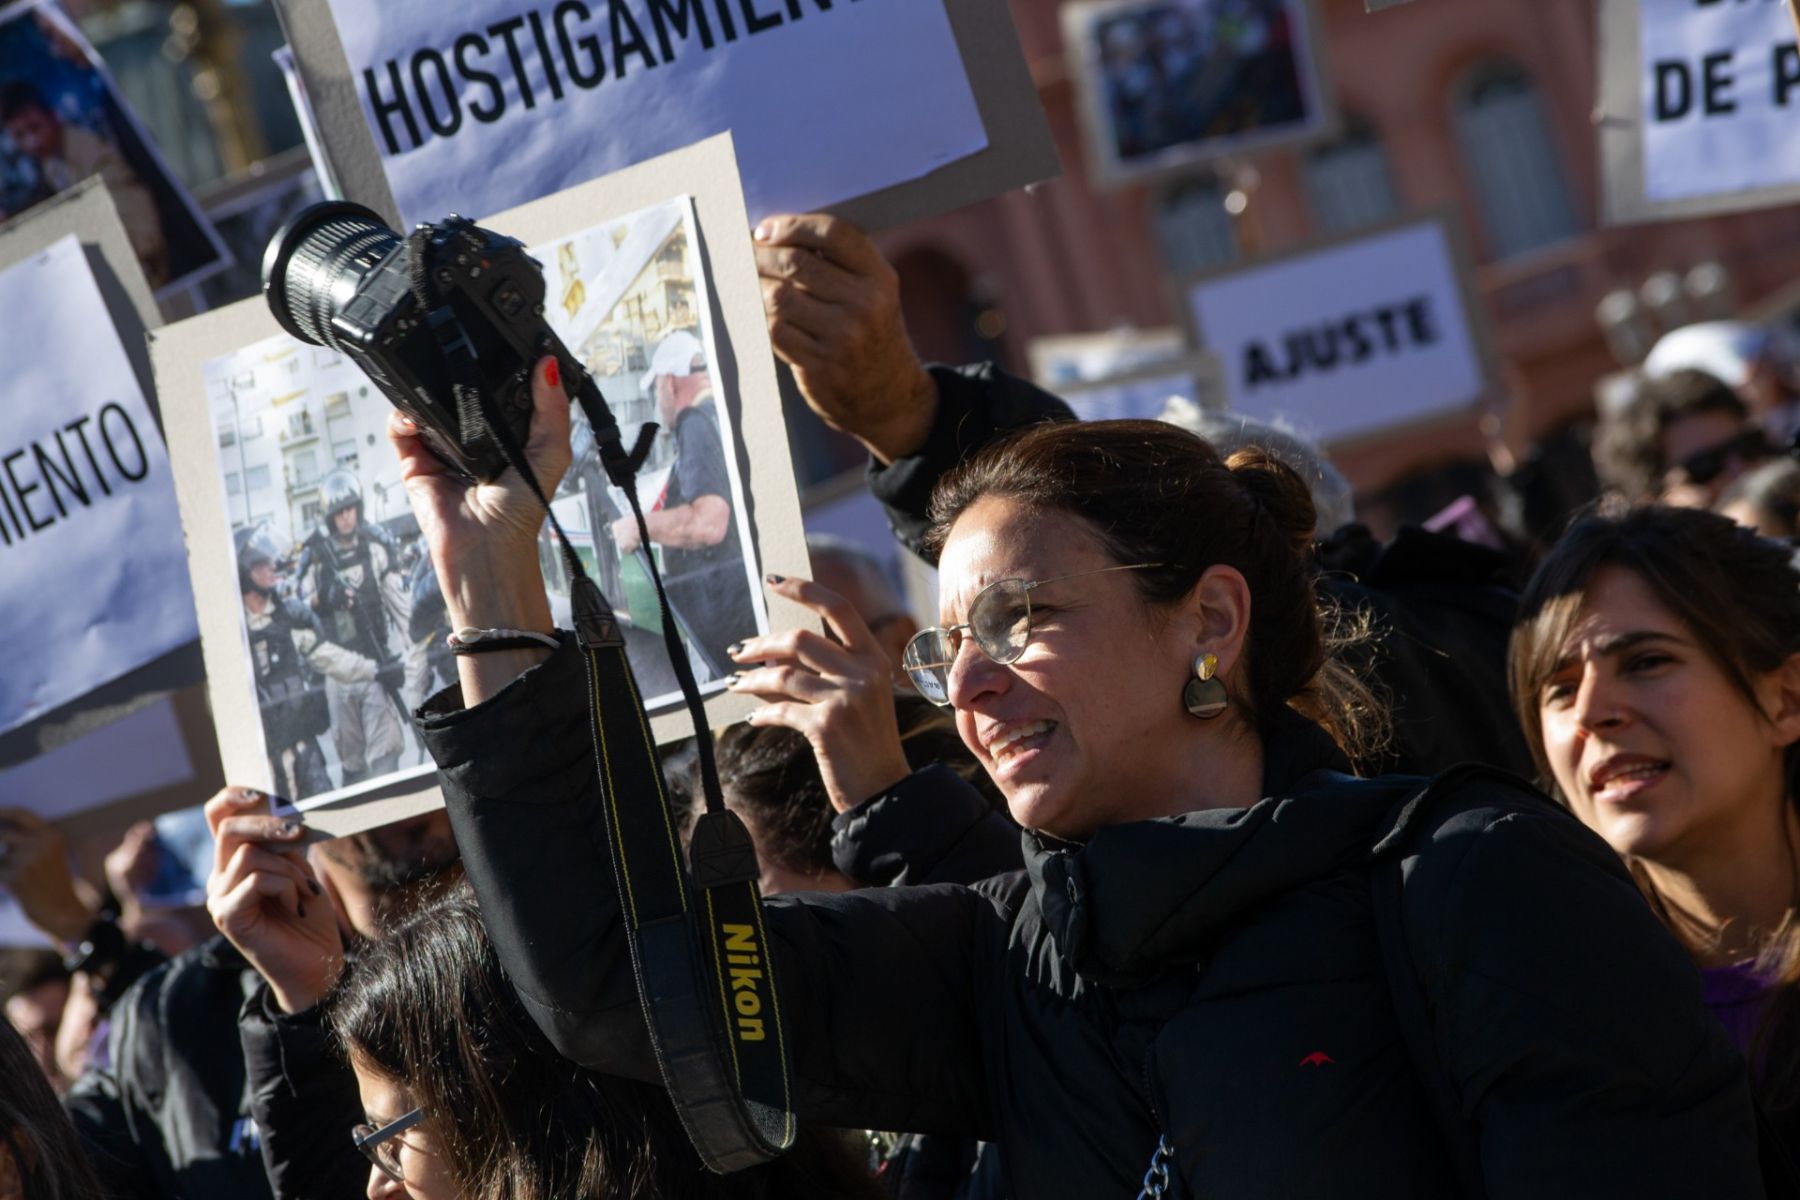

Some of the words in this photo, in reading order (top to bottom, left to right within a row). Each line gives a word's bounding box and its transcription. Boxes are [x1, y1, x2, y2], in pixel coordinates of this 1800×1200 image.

[363, 0, 864, 156] HOSTIGAM
[1655, 52, 1736, 122] DE
[1243, 296, 1437, 390] AJUSTE
[0, 401, 149, 545] IENTO
[722, 923, 765, 1041] Nikon
